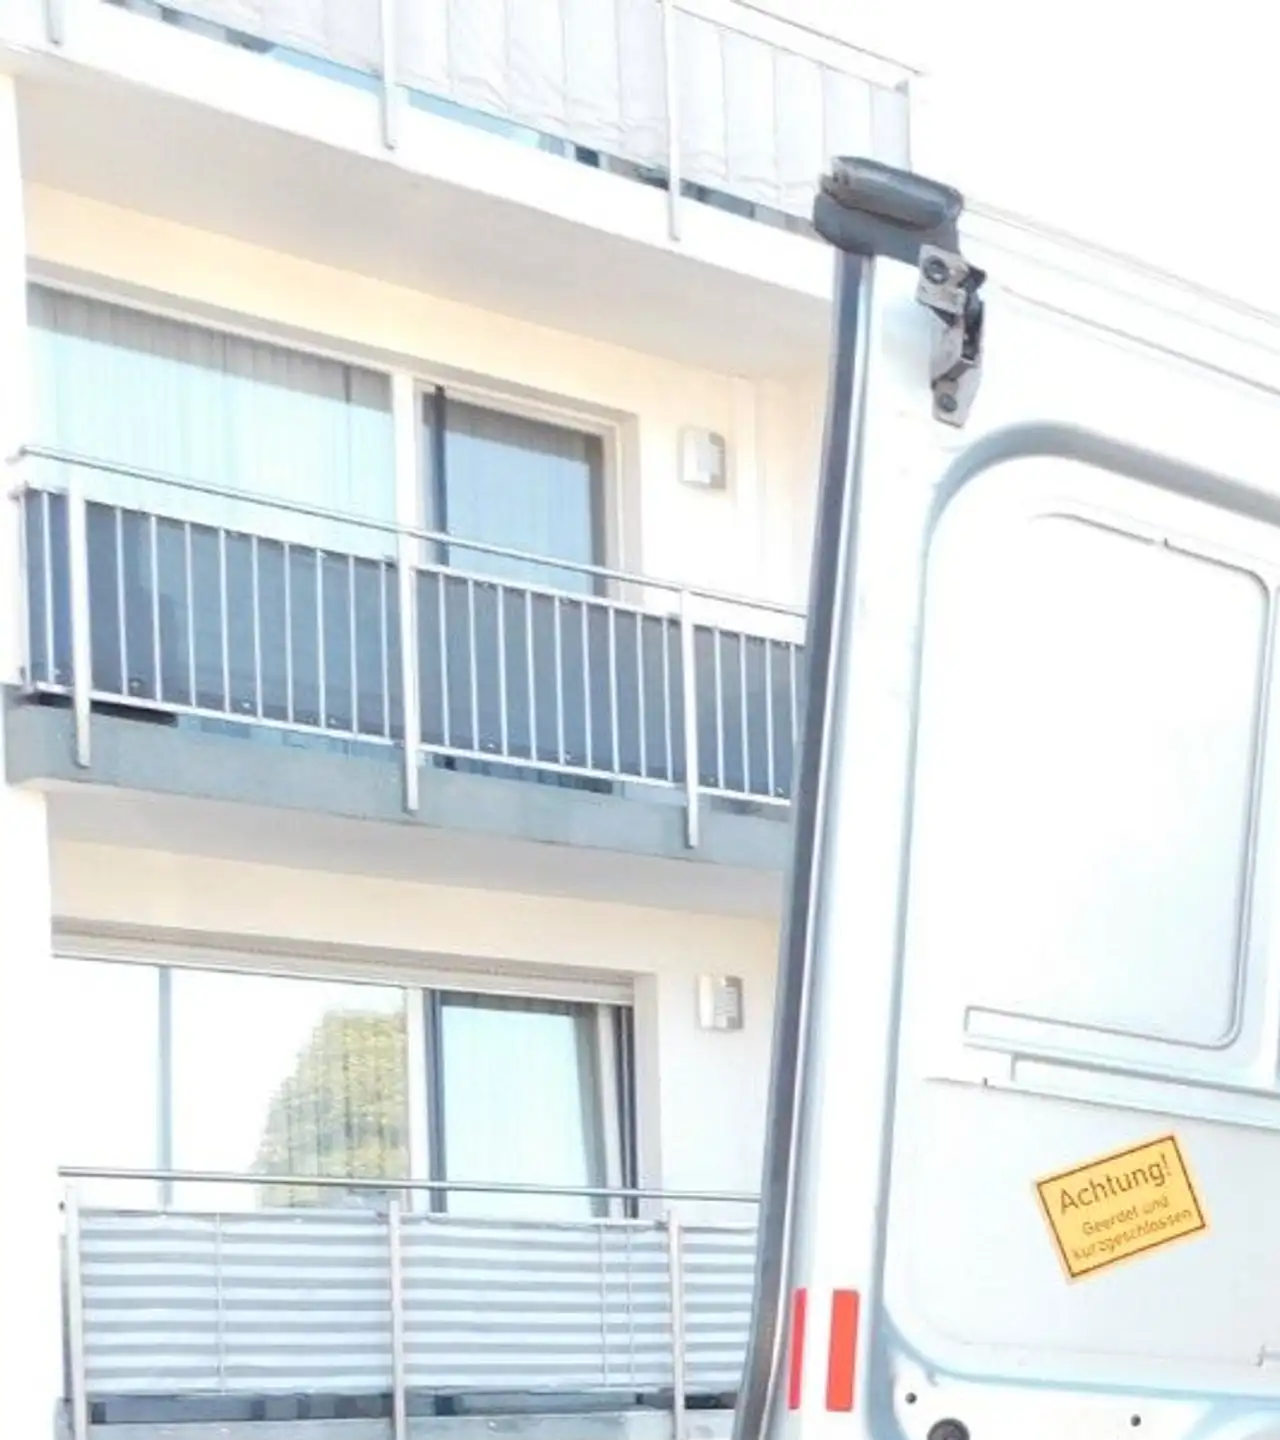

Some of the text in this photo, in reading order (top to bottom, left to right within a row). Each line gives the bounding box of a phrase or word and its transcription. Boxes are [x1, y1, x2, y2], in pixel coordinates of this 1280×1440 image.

[1060, 1152, 1173, 1215] Achtung!
[1082, 1194, 1171, 1236] Geerdet und
